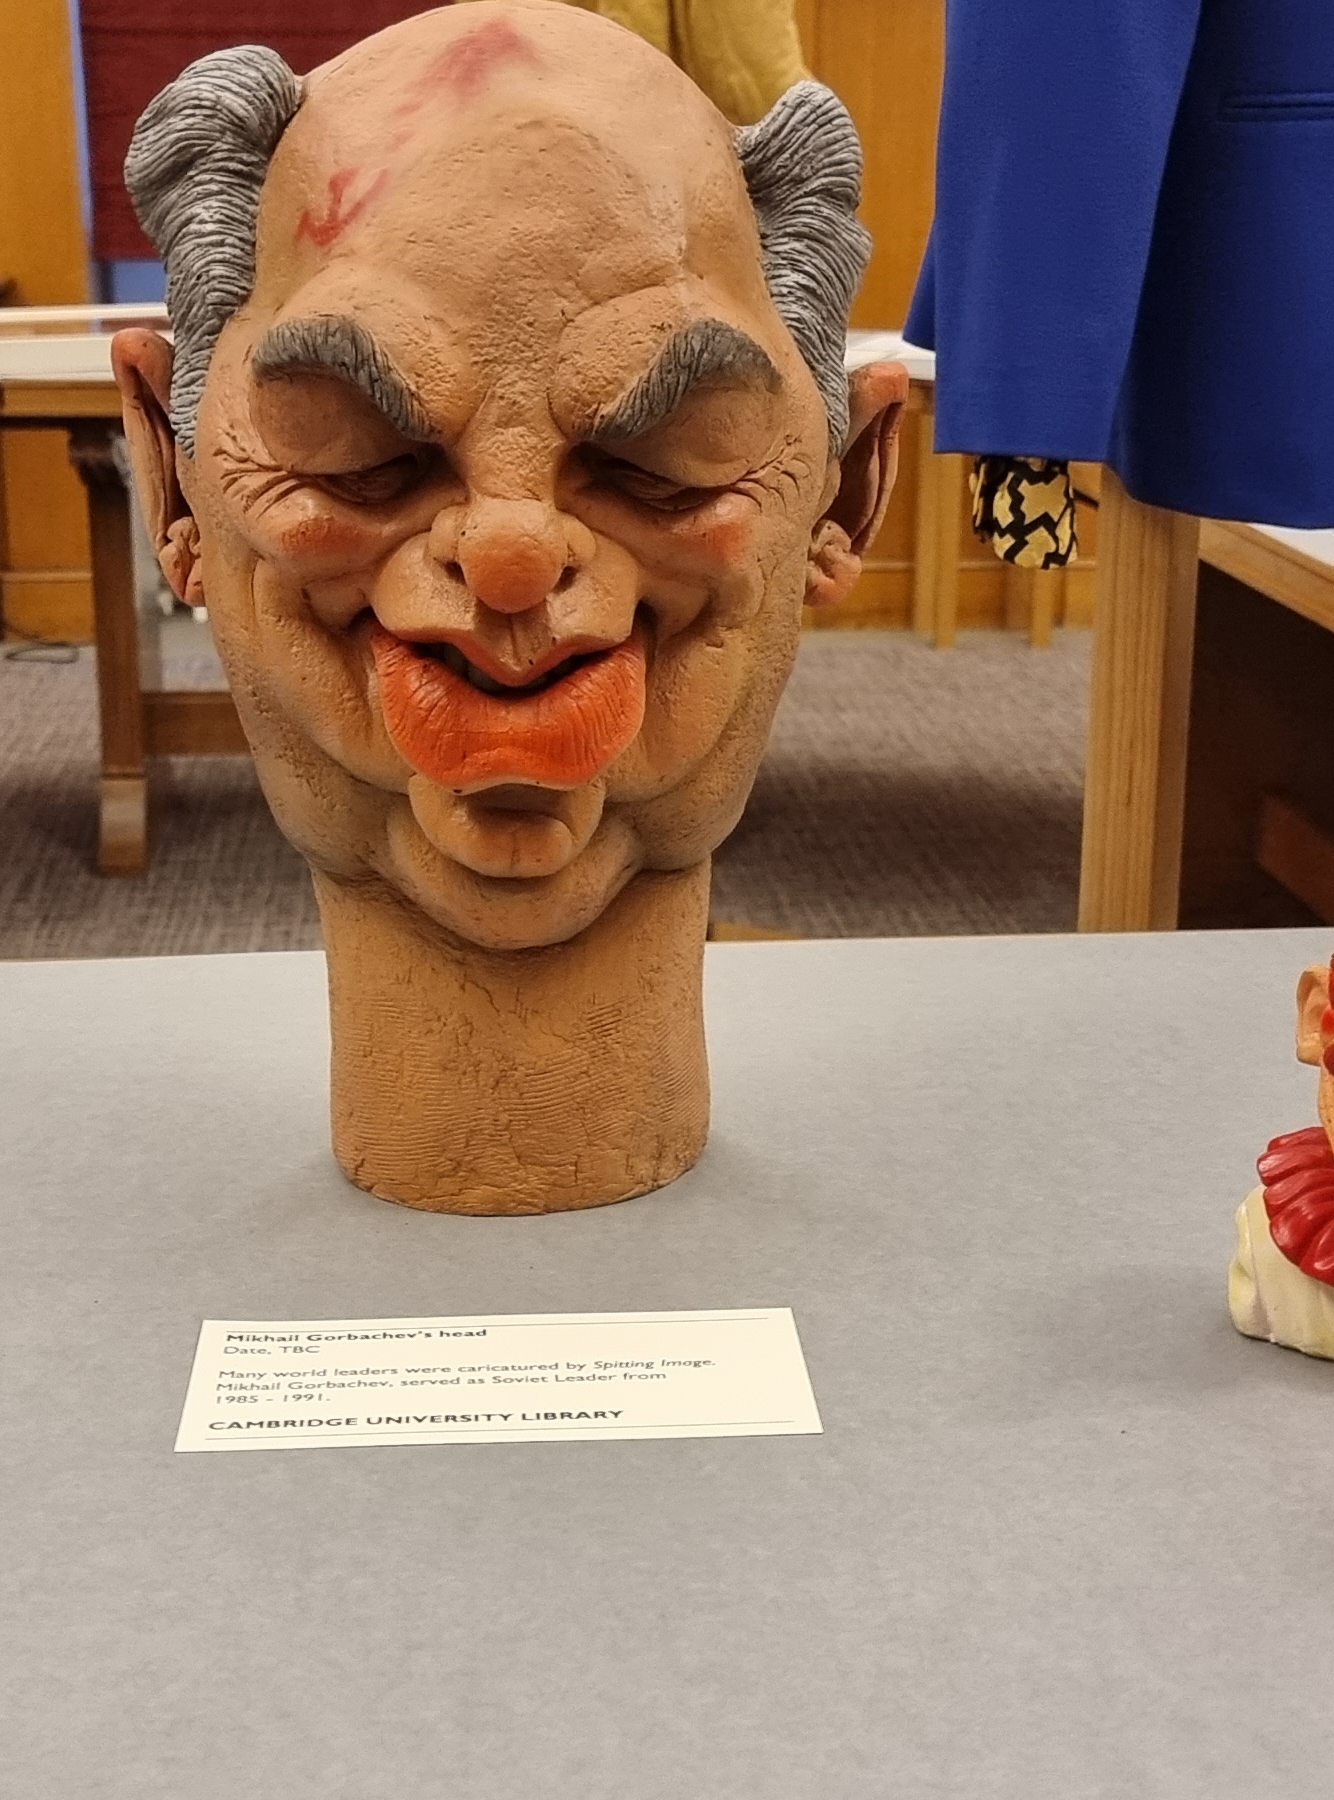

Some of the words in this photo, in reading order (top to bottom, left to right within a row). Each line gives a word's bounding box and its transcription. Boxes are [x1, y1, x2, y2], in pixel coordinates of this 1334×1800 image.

[226, 1334, 299, 1342] Mikhail
[307, 1331, 433, 1341] Gorbachev's
[439, 1329, 488, 1337] head
[223, 1346, 272, 1355] Date,
[279, 1345, 321, 1354] TBC
[218, 1371, 267, 1380] Many
[273, 1369, 327, 1377] world
[334, 1368, 399, 1376] leaders
[404, 1366, 452, 1374] were
[457, 1362, 559, 1372] caricatured
[566, 1362, 586, 1371] by
[594, 1360, 655, 1370] Spitting
[661, 1359, 716, 1368] Image.
[216, 1382, 281, 1391] Mikhail
[287, 1380, 394, 1389] Gorbachev,
[400, 1378, 460, 1386] served
[492, 1375, 549, 1384] Soviet
[554, 1374, 617, 1383] Leader
[623, 1372, 667, 1380] from
[216, 1395, 259, 1404] 1985
[283, 1394, 332, 1402] 1991.
[208, 1418, 359, 1430] CAMBRIDGE
[366, 1413, 514, 1424] UNIVERSITY
[521, 1410, 624, 1421] LIBRARY
